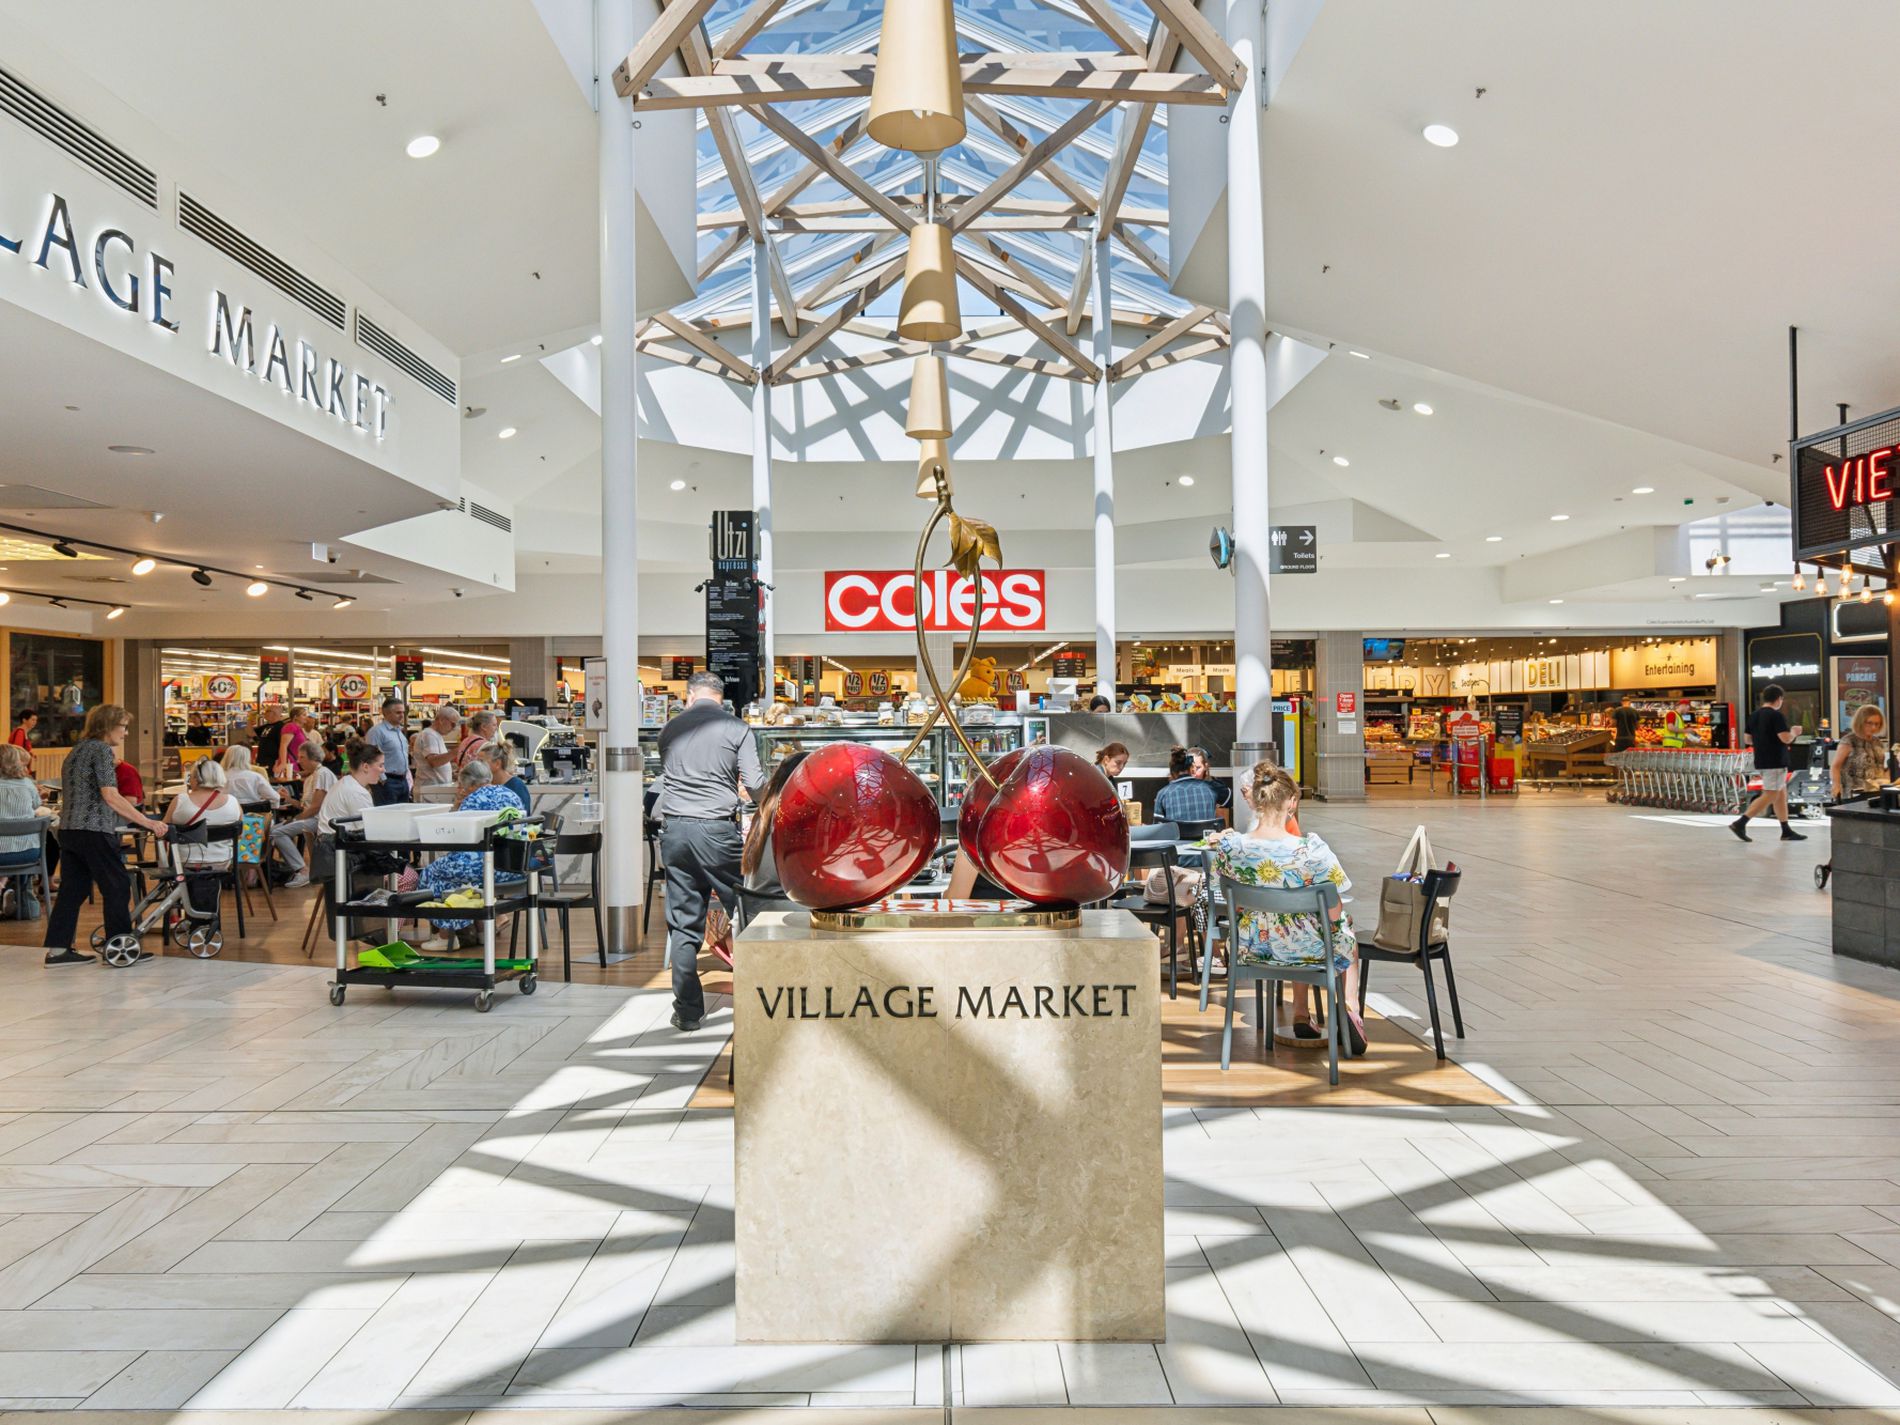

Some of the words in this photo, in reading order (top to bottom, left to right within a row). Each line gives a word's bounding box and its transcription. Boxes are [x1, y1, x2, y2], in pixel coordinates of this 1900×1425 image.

[0, 192, 181, 334] AGE
[208, 290, 389, 439] MARKET
[717, 511, 747, 559] Utzi
[718, 560, 748, 572] espresso
[828, 570, 1043, 628] coles
[1528, 662, 1561, 688] DELI
[1645, 662, 1695, 676] Entertaining
[847, 674, 860, 686] 1/2
[873, 674, 886, 685] 1/2
[1010, 673, 1021, 684] 1/2
[1846, 672, 1877, 682] PANCAKE
[340, 679, 367, 692] 40%
[1122, 785, 1128, 796] 7
[756, 986, 938, 1020] VILLAGE
[955, 984, 1137, 1020] MARKET
